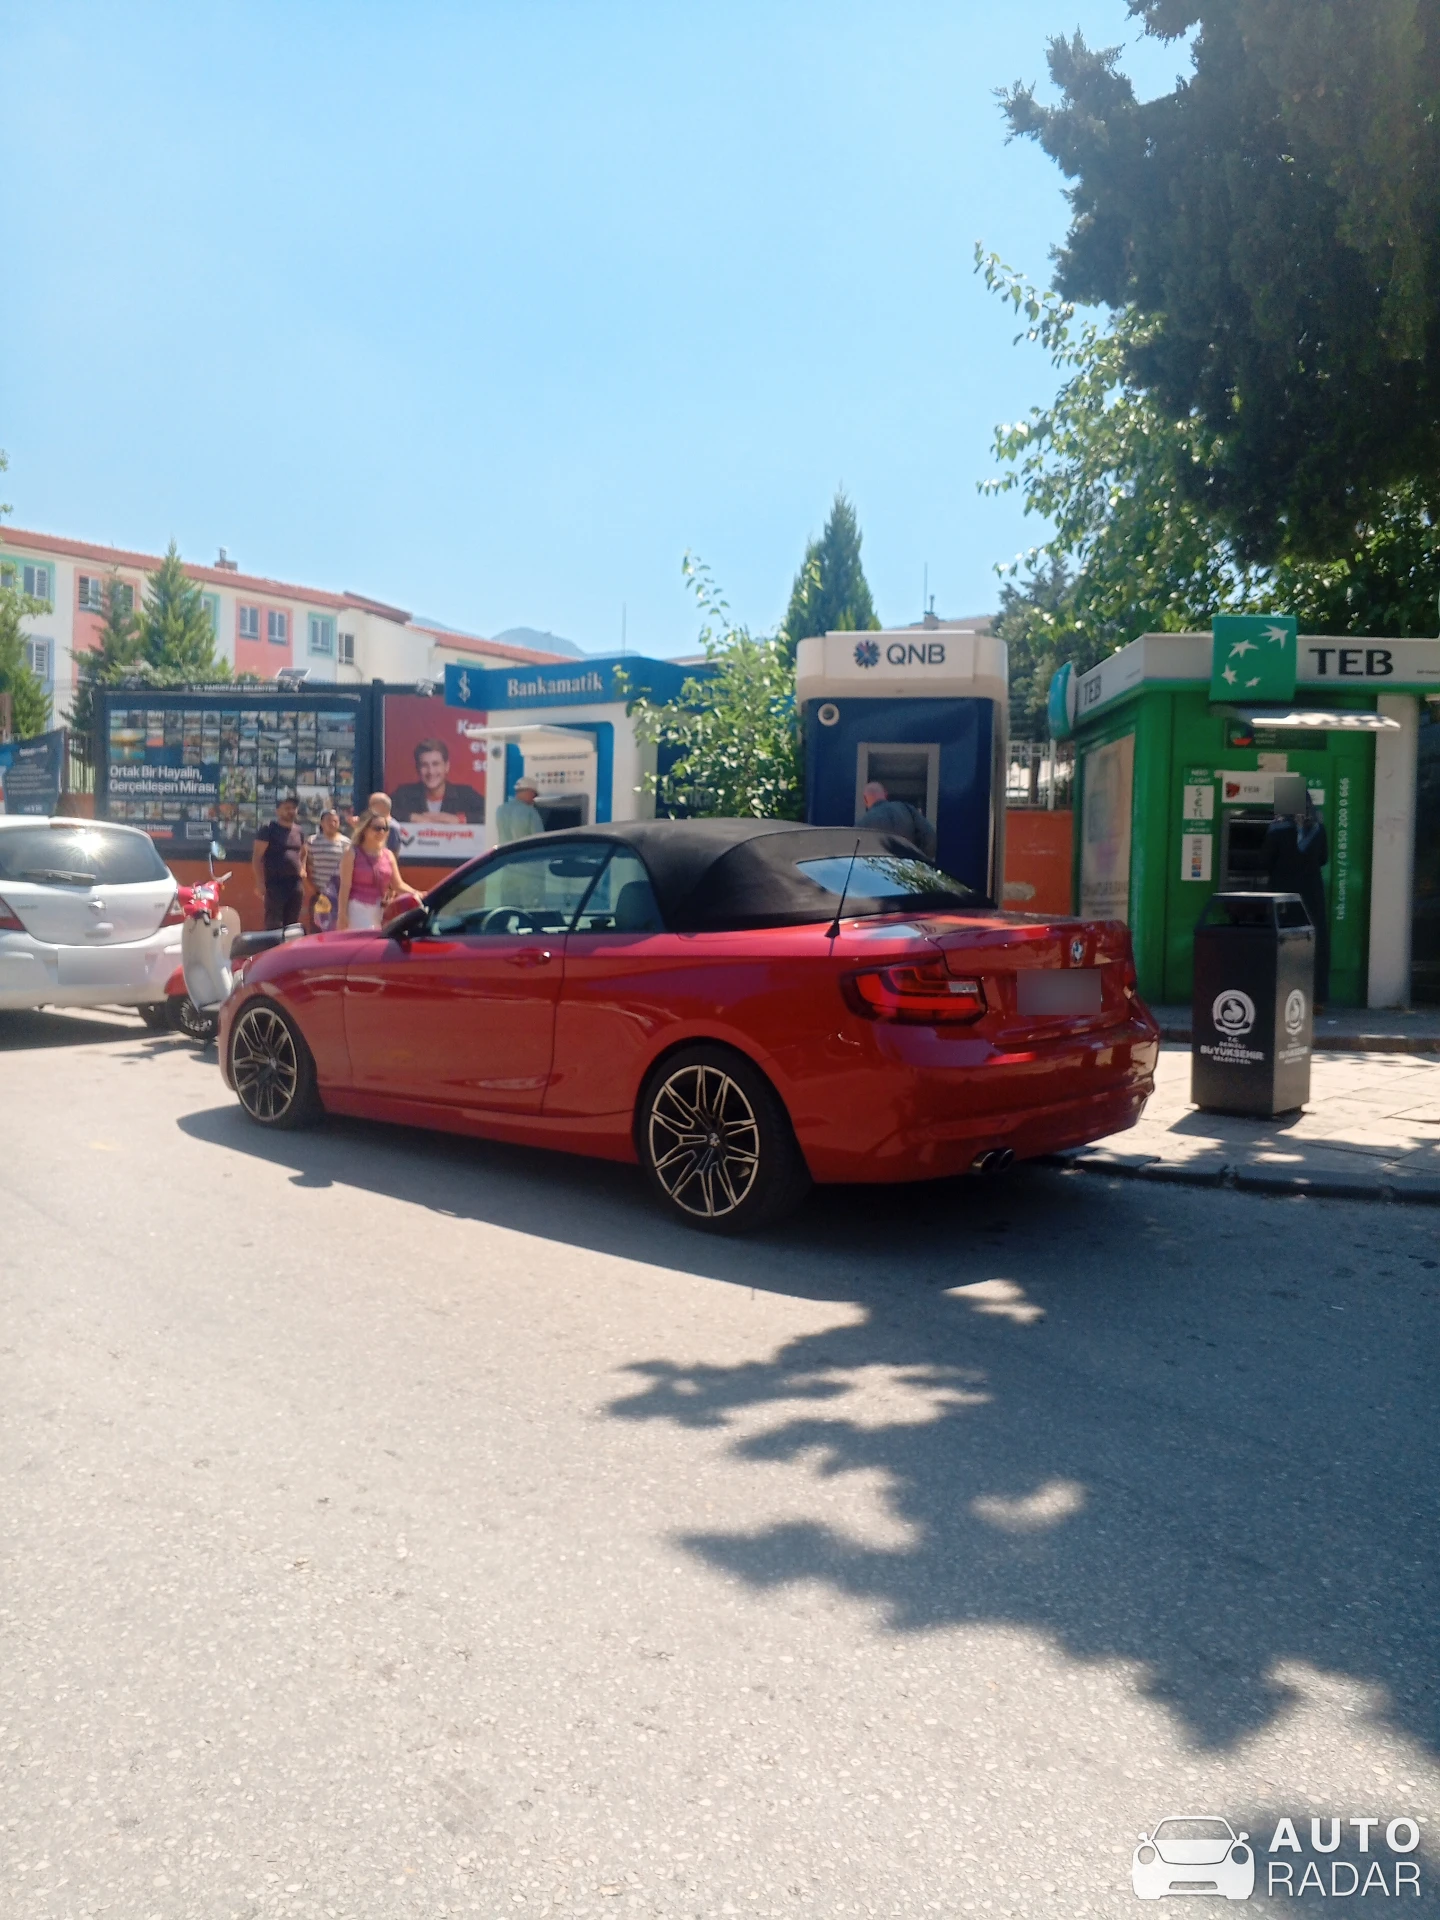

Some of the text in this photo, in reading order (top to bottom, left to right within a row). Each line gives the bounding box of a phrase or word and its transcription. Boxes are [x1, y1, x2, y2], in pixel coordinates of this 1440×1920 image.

[887, 643, 945, 665] QNB
[1308, 648, 1393, 676] TEB
[507, 671, 603, 697] Bankamatik
[1084, 674, 1101, 705] TEB
[109, 764, 203, 781] Ortak Bir Hayalin,
[109, 779, 218, 796] Gerçekleşen Mirası.
